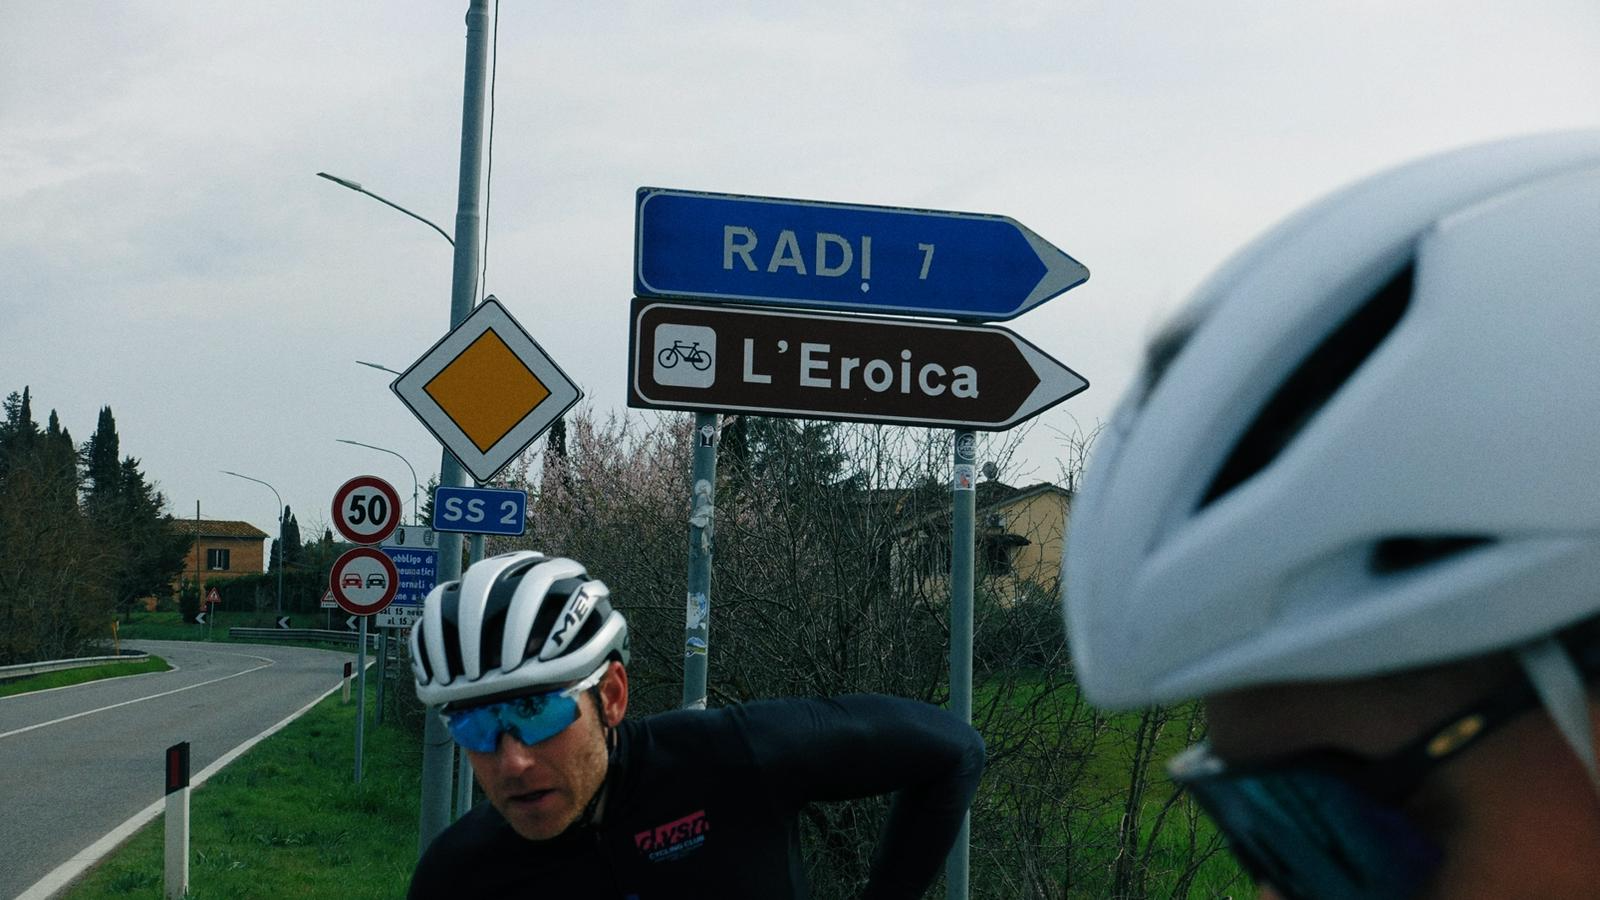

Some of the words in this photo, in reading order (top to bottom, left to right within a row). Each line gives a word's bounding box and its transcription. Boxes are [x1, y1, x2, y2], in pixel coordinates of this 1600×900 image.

[918, 242, 935, 280] 7
[742, 338, 980, 399] L'Eroica
[348, 495, 387, 525] 50
[443, 497, 485, 522] SS
[500, 500, 517, 524] 2
[395, 607, 404, 616] 15
[399, 617, 408, 625] 15
[551, 585, 590, 647] MET
